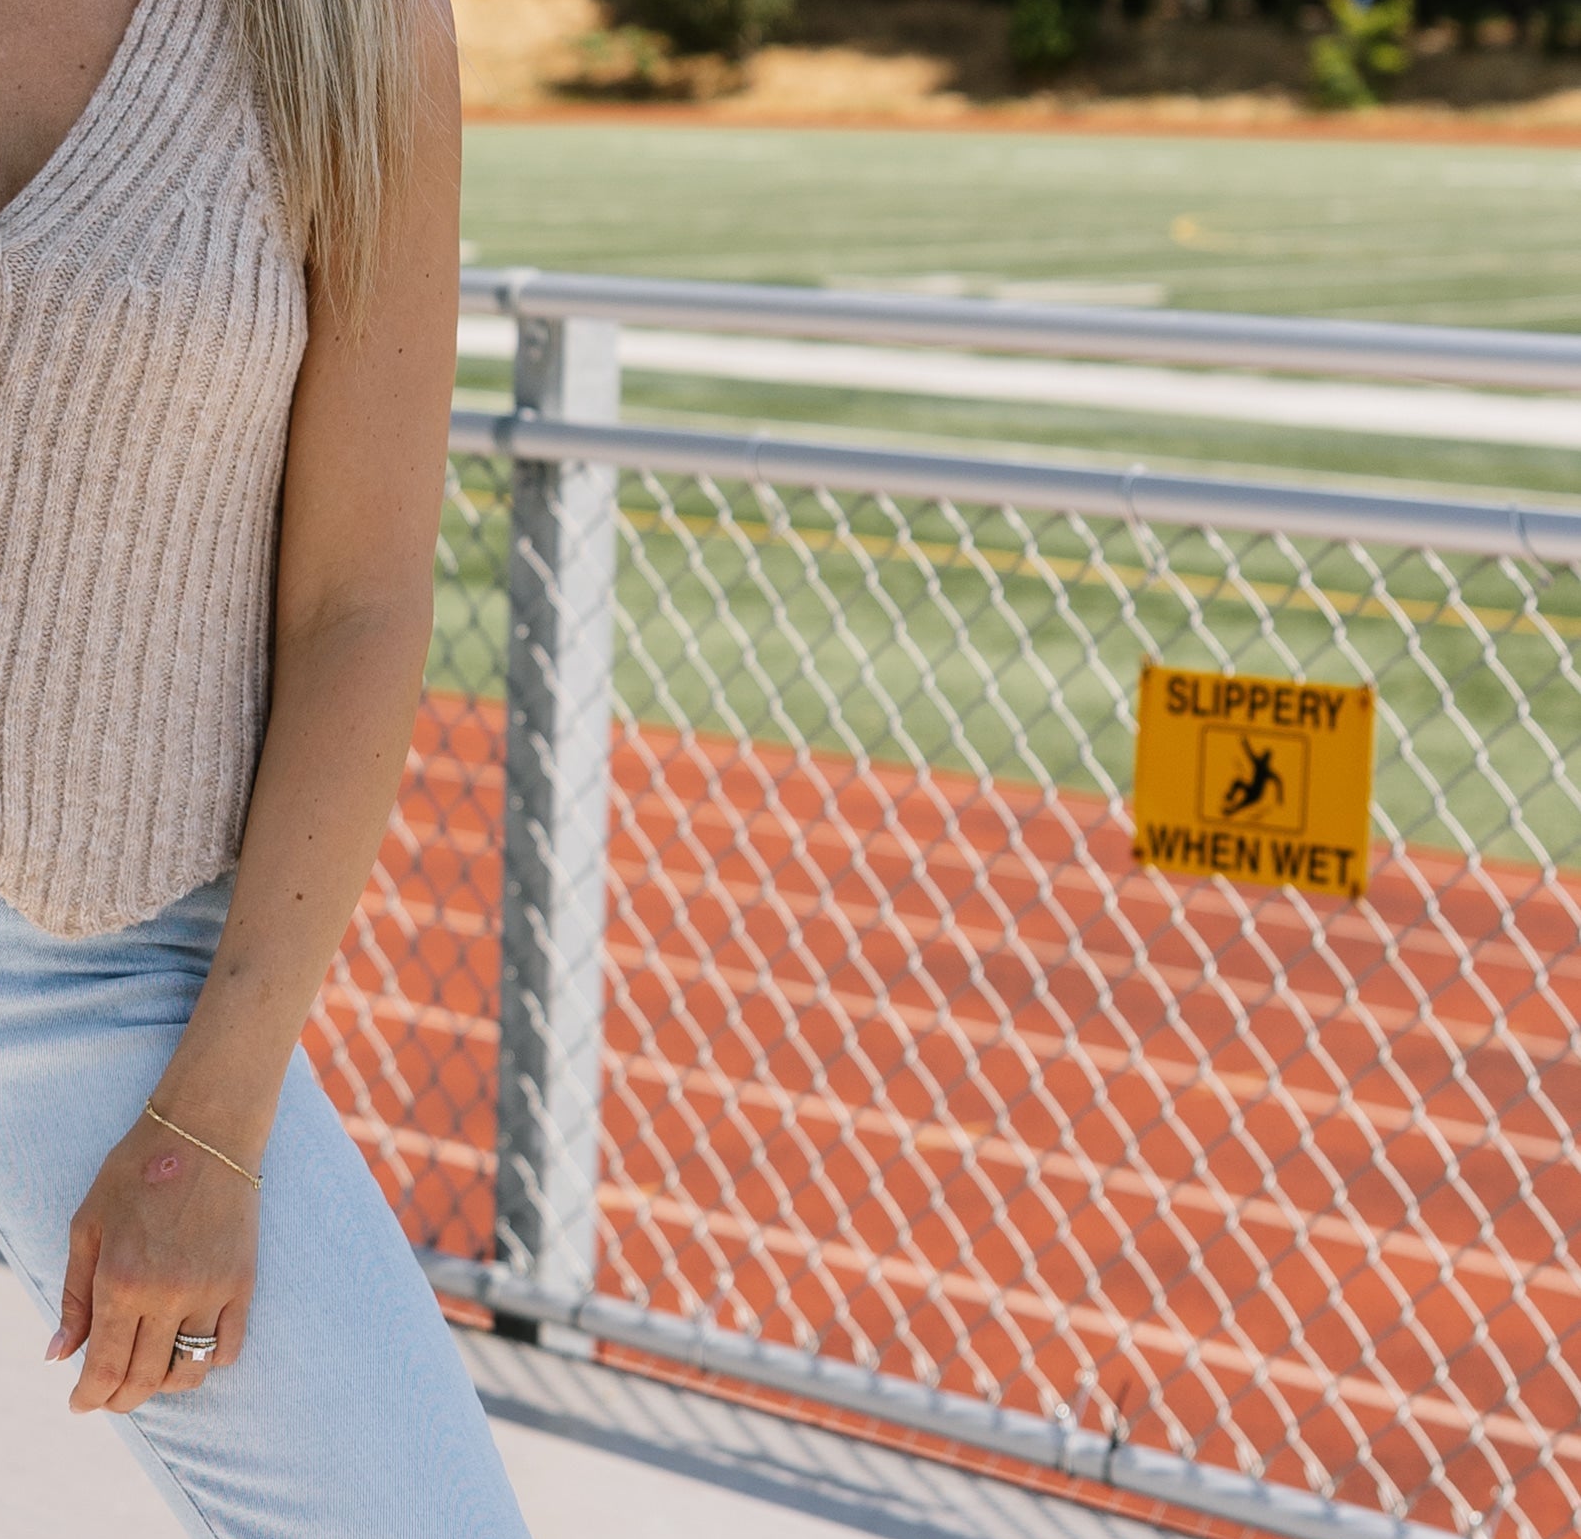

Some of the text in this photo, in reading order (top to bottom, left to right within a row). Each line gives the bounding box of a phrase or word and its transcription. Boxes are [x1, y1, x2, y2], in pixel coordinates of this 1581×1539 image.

[1166, 676, 1344, 730] SLIPPERY
[1147, 823, 1356, 887] WHEN WET
